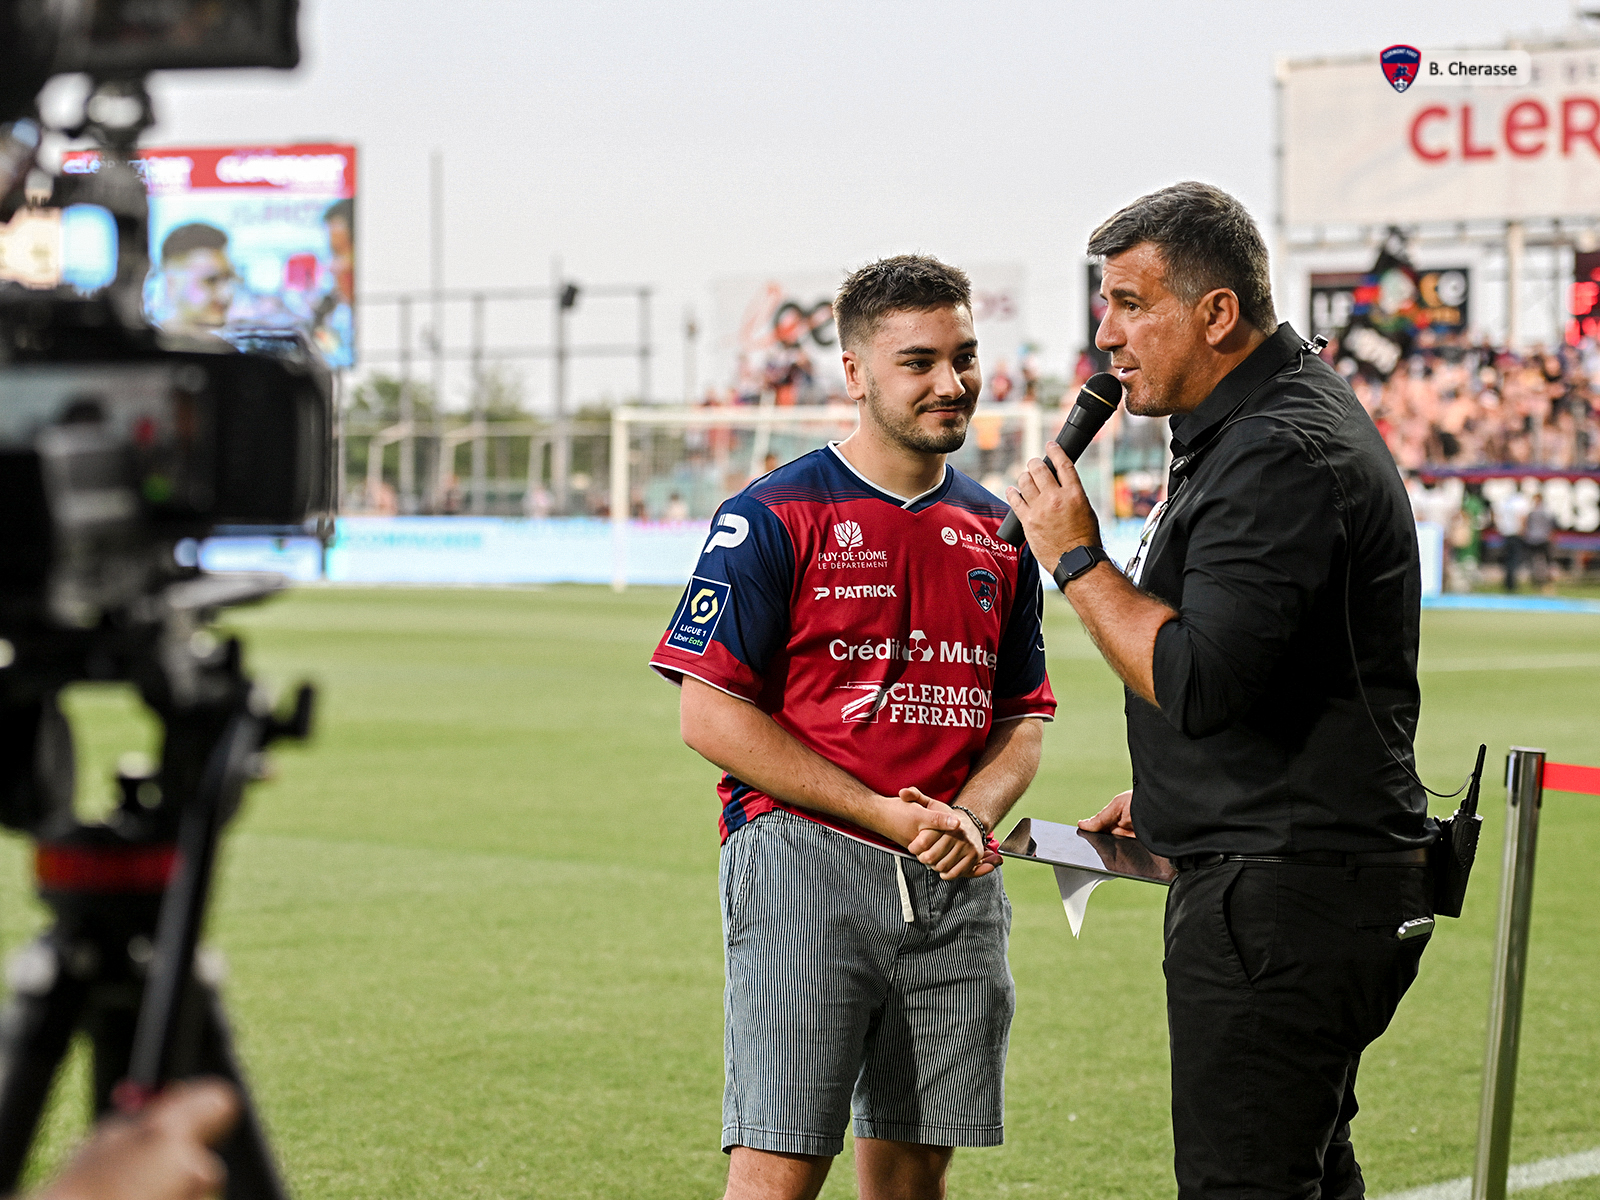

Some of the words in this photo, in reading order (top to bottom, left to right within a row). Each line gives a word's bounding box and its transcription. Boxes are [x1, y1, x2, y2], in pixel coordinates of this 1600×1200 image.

[959, 529, 973, 543] La
[818, 562, 827, 570] LE
[831, 561, 888, 570] DÉPARTEMENT
[835, 584, 897, 600] PATRICK
[680, 624, 702, 636] LIGUE
[702, 630, 707, 638] 1
[673, 632, 689, 643] Uber
[688, 636, 704, 647] Eats
[829, 637, 900, 661] Crédit
[940, 641, 997, 671] Mutue
[890, 682, 993, 710] CLERMON
[889, 704, 986, 729] FERRAND
